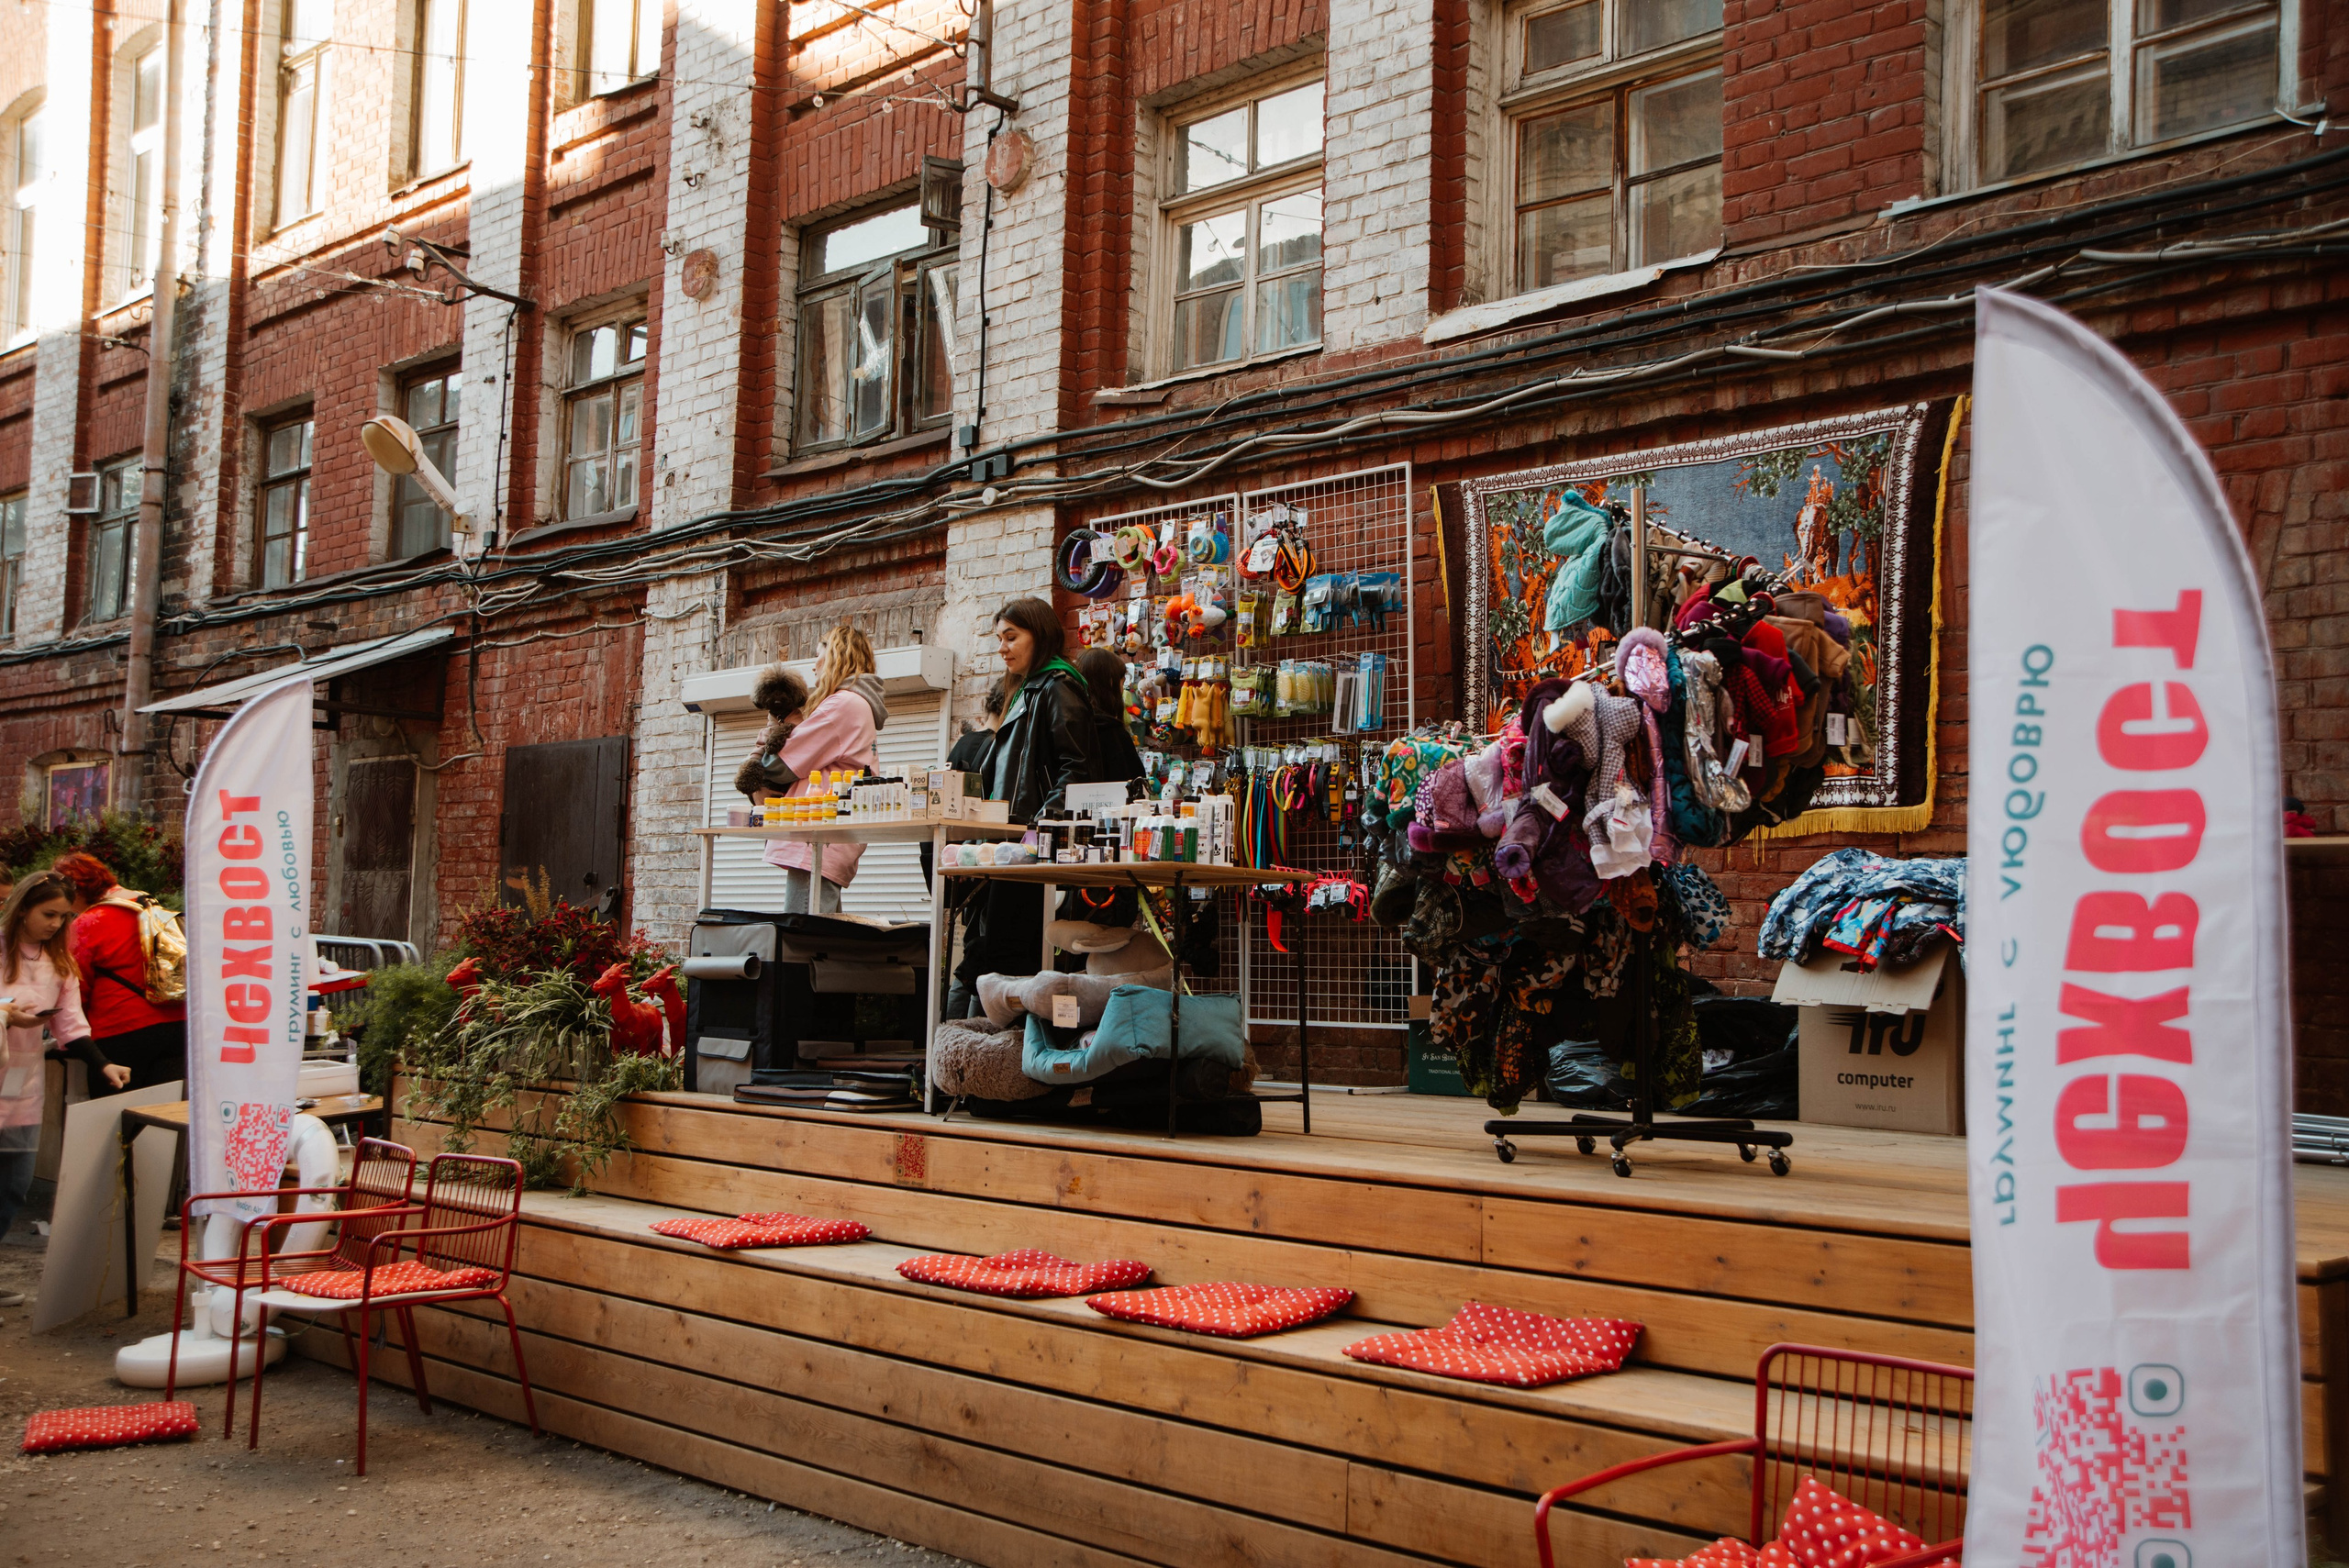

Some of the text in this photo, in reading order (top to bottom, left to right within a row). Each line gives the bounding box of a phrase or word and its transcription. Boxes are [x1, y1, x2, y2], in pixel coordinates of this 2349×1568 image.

[276, 810, 301, 912] любовью
[287, 954, 301, 1043] груминг
[1837, 1073, 1914, 1089] computer
[1854, 1103, 1897, 1113] www.iru.ru
